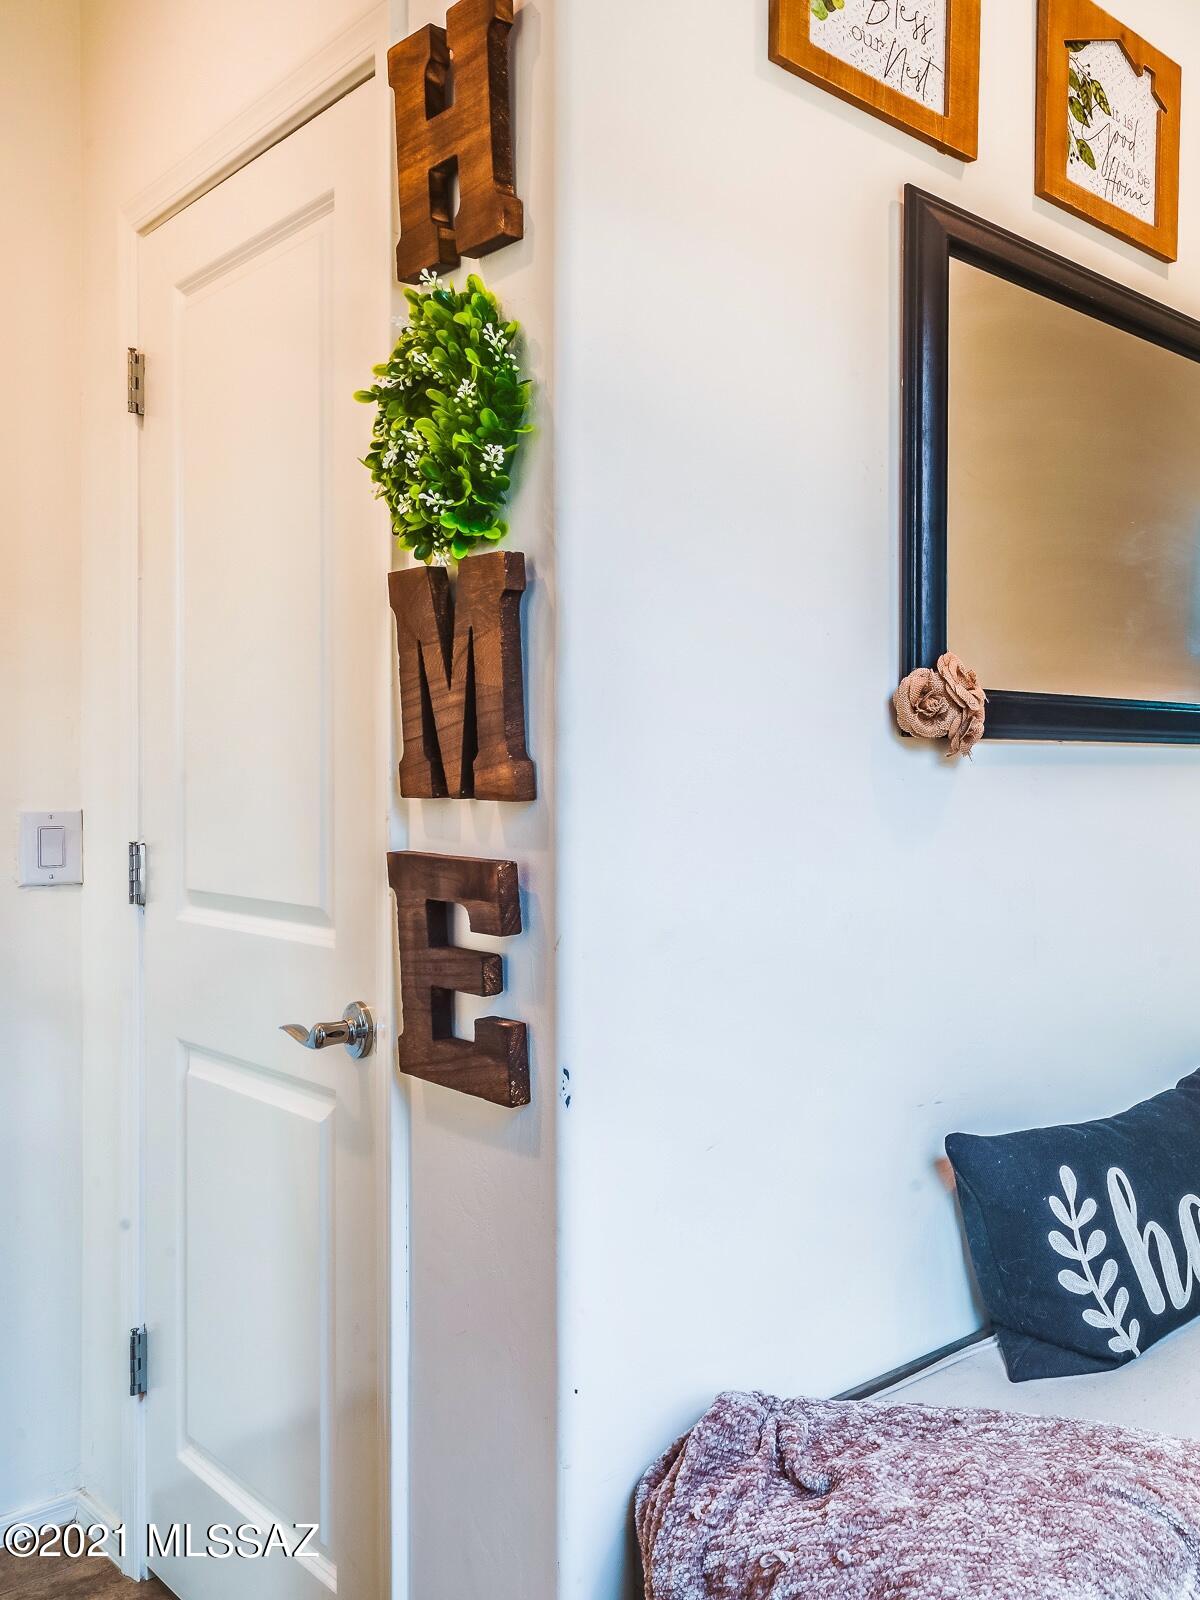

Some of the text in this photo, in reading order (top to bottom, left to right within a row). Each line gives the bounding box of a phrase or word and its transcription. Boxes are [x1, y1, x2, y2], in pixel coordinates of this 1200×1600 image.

[851, 25, 885, 53] our
[884, 37, 943, 101] Nest
[1136, 168, 1151, 189] be
